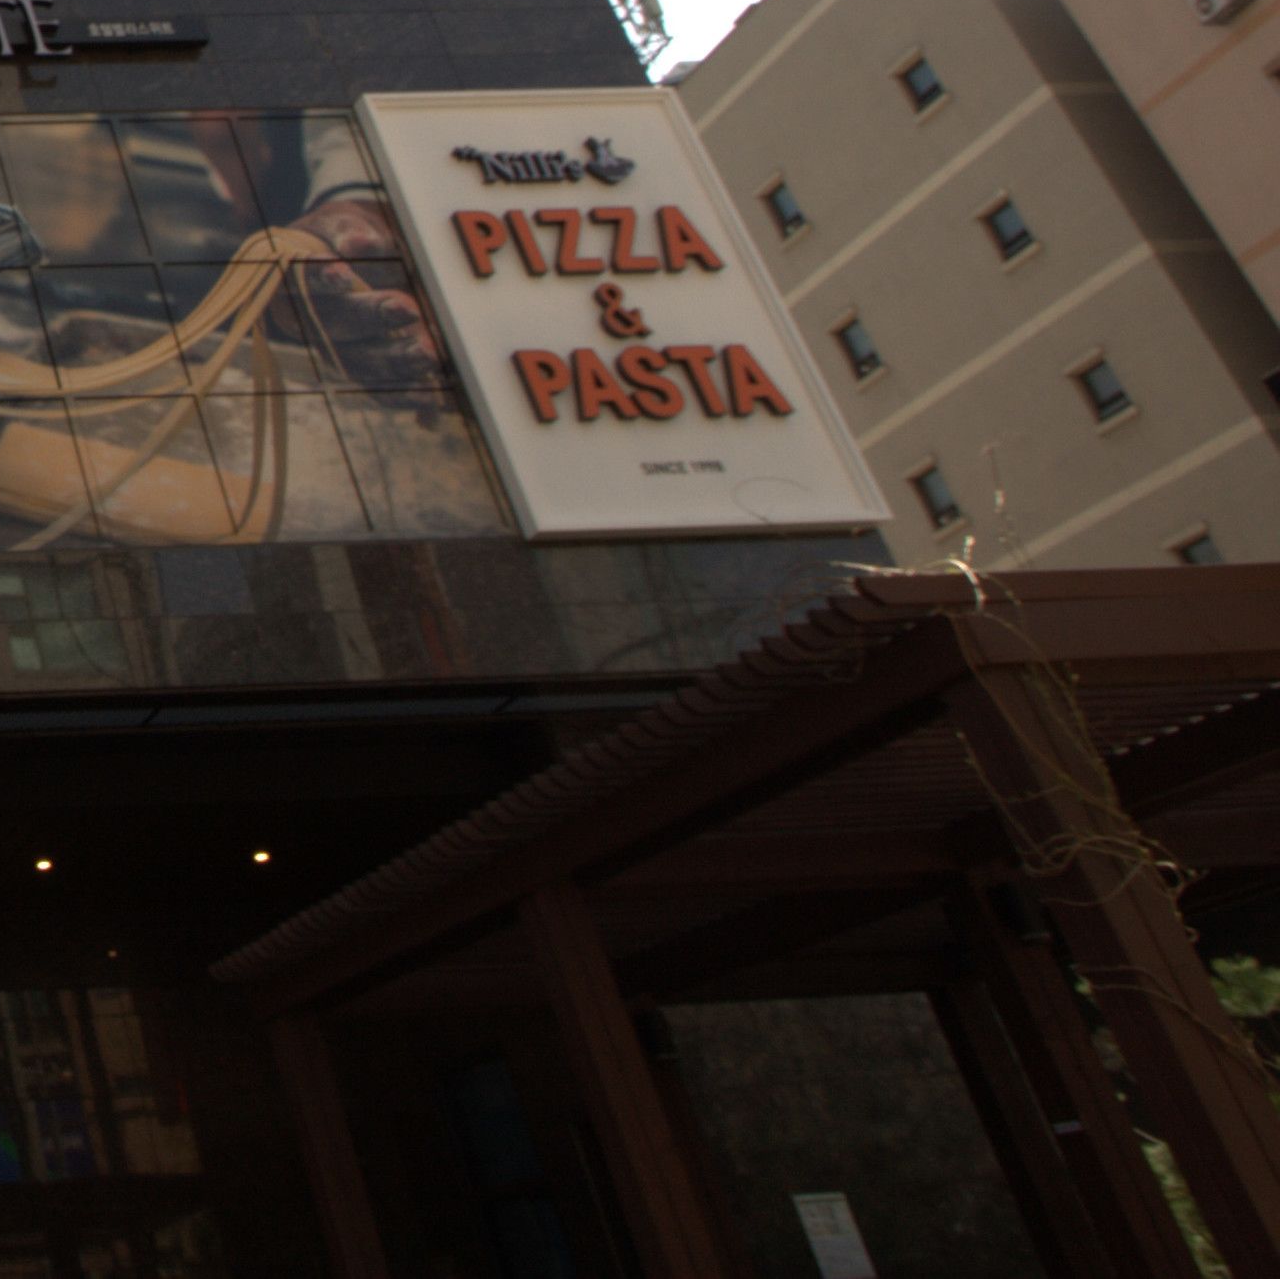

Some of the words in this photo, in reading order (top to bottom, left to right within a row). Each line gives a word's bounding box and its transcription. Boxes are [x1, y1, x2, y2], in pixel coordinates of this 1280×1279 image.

[479, 151, 584, 185] Nilli's
[451, 204, 726, 278] PIZZA
[594, 283, 651, 338] &
[512, 344, 794, 423] PASTA
[640, 461, 687, 475] SINCE
